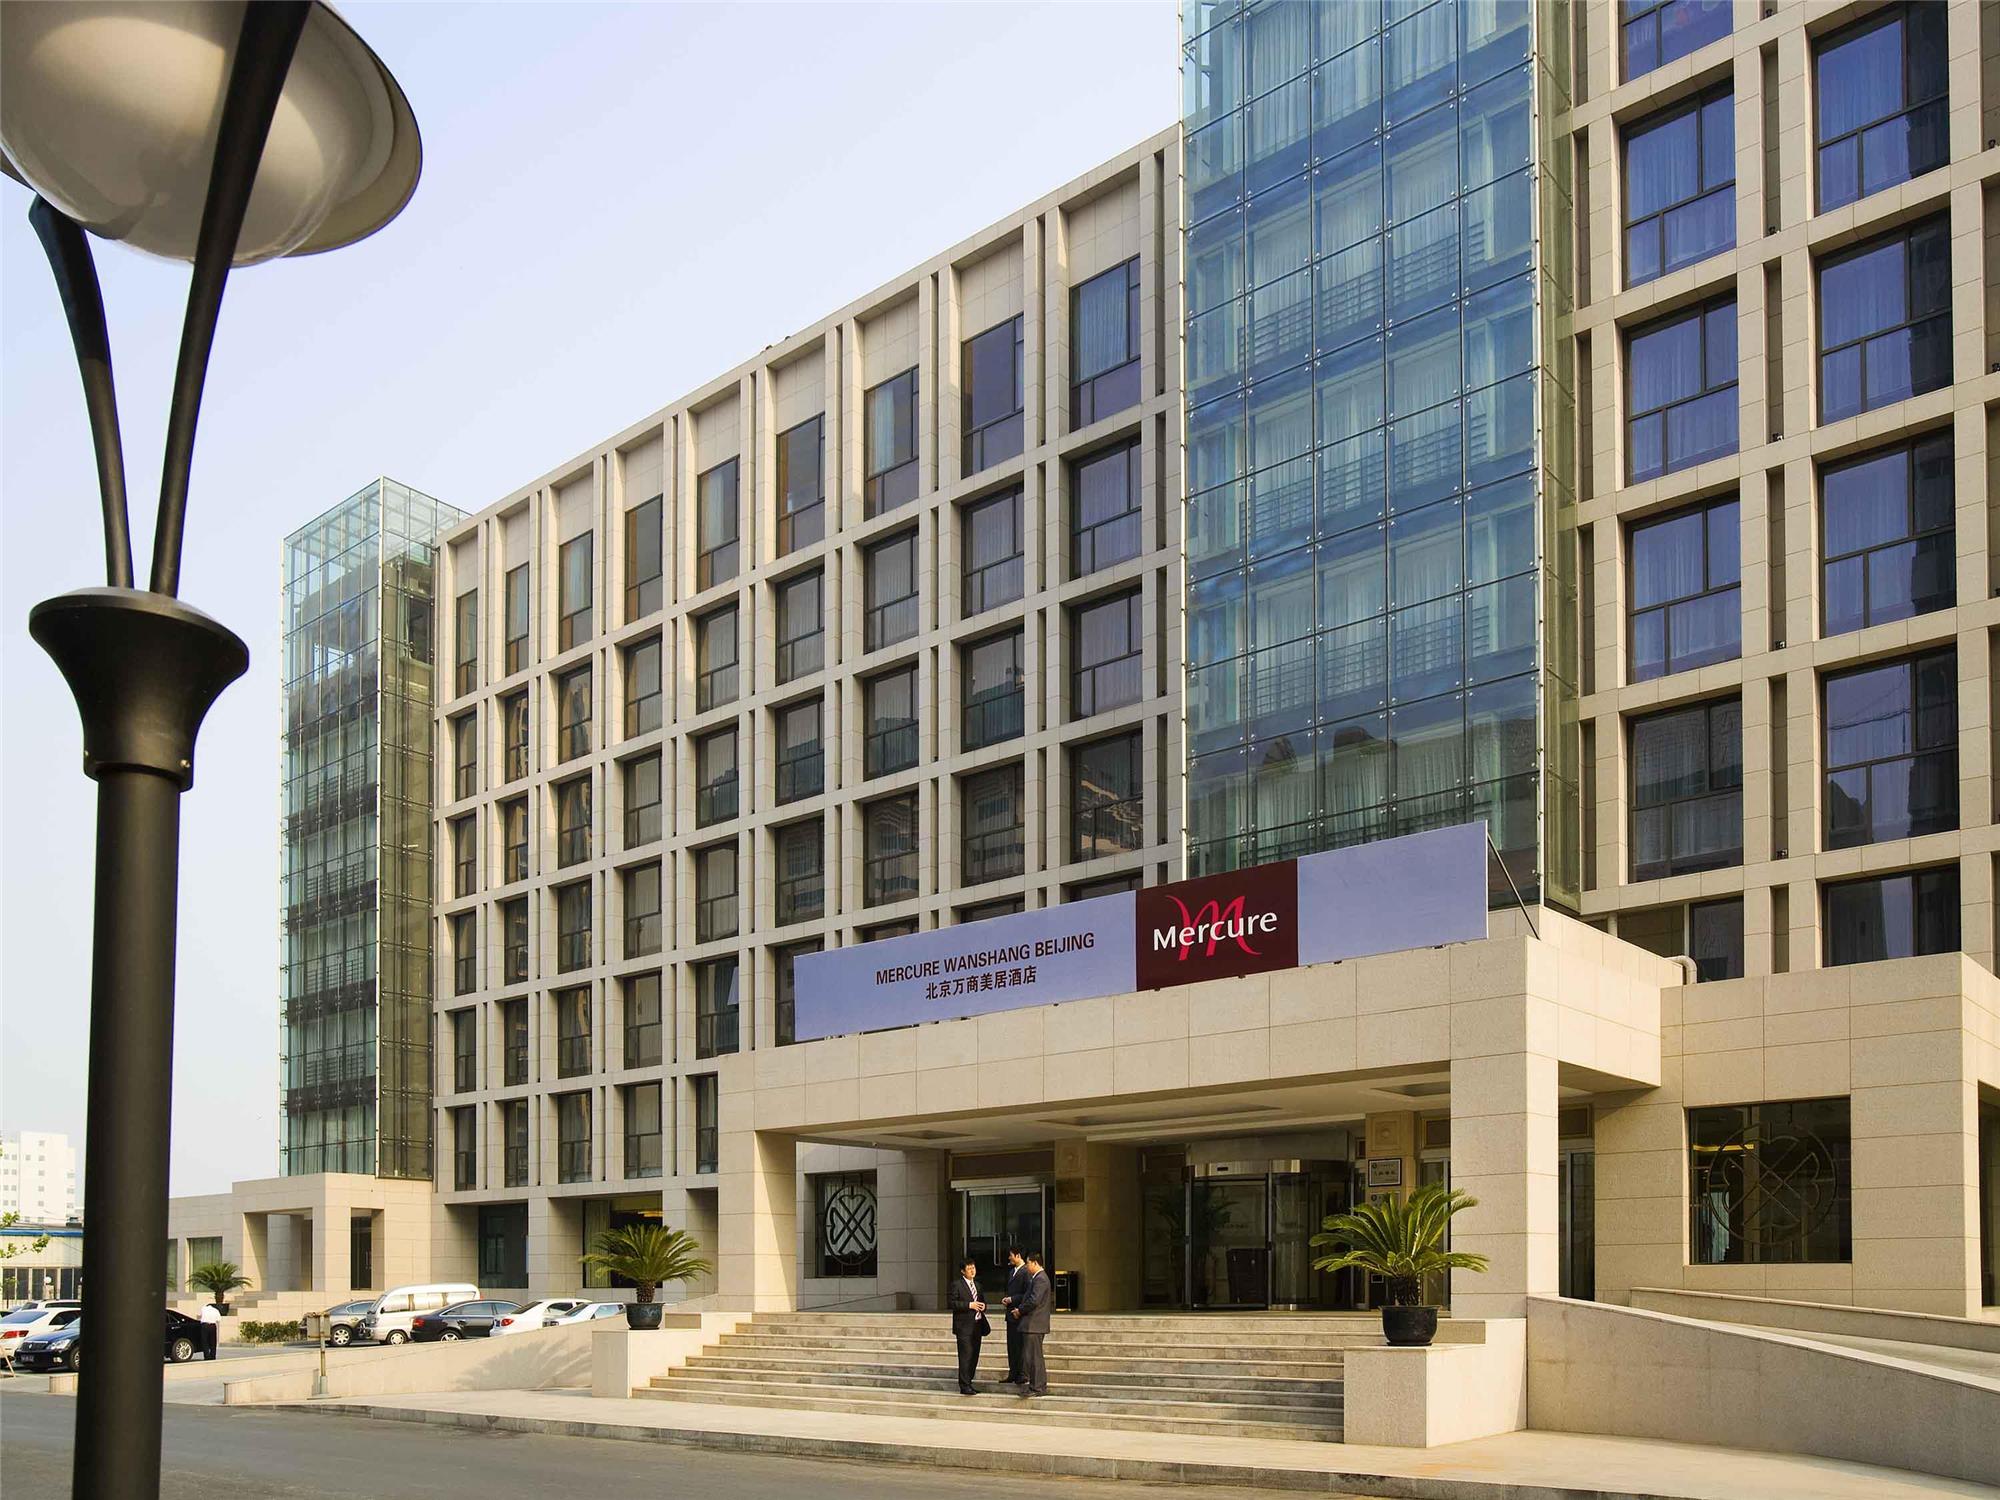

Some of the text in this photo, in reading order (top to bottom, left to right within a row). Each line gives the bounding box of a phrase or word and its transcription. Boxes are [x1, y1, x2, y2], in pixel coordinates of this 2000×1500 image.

[1153, 912, 1278, 951] Mercure
[876, 932, 1095, 985] MERCURE WANSHANG BEIJING
[925, 965, 1037, 1001] 北京万商美居酒店
